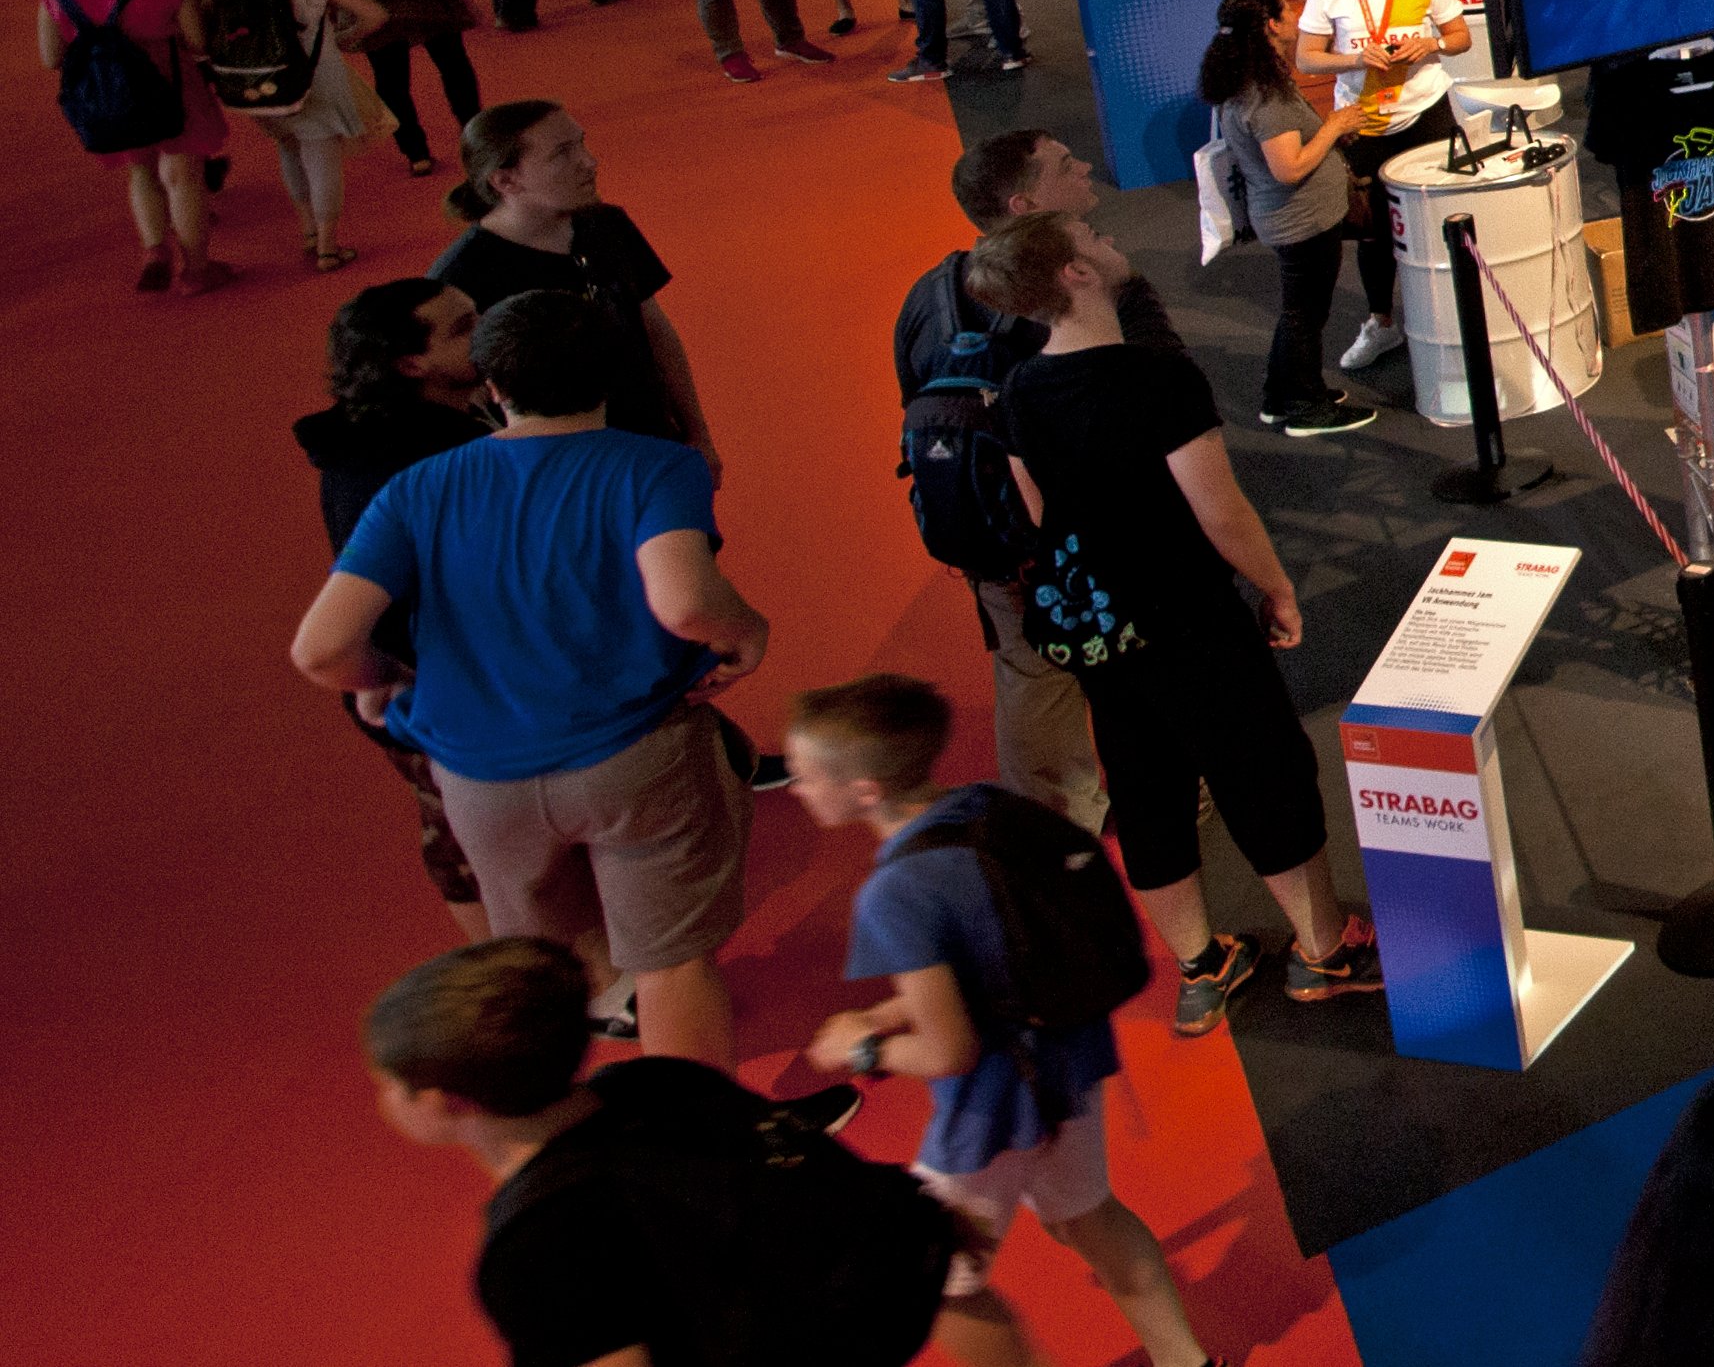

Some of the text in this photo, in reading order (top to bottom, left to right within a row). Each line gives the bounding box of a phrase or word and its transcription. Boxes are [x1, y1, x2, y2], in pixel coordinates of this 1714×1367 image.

[1515, 563, 1560, 574] STRABAG
[1428, 587, 1475, 598] Jackhammer
[1434, 597, 1480, 610] Anwendung
[1359, 789, 1478, 820] STRABAG
[1376, 813, 1420, 828] TEAMS
